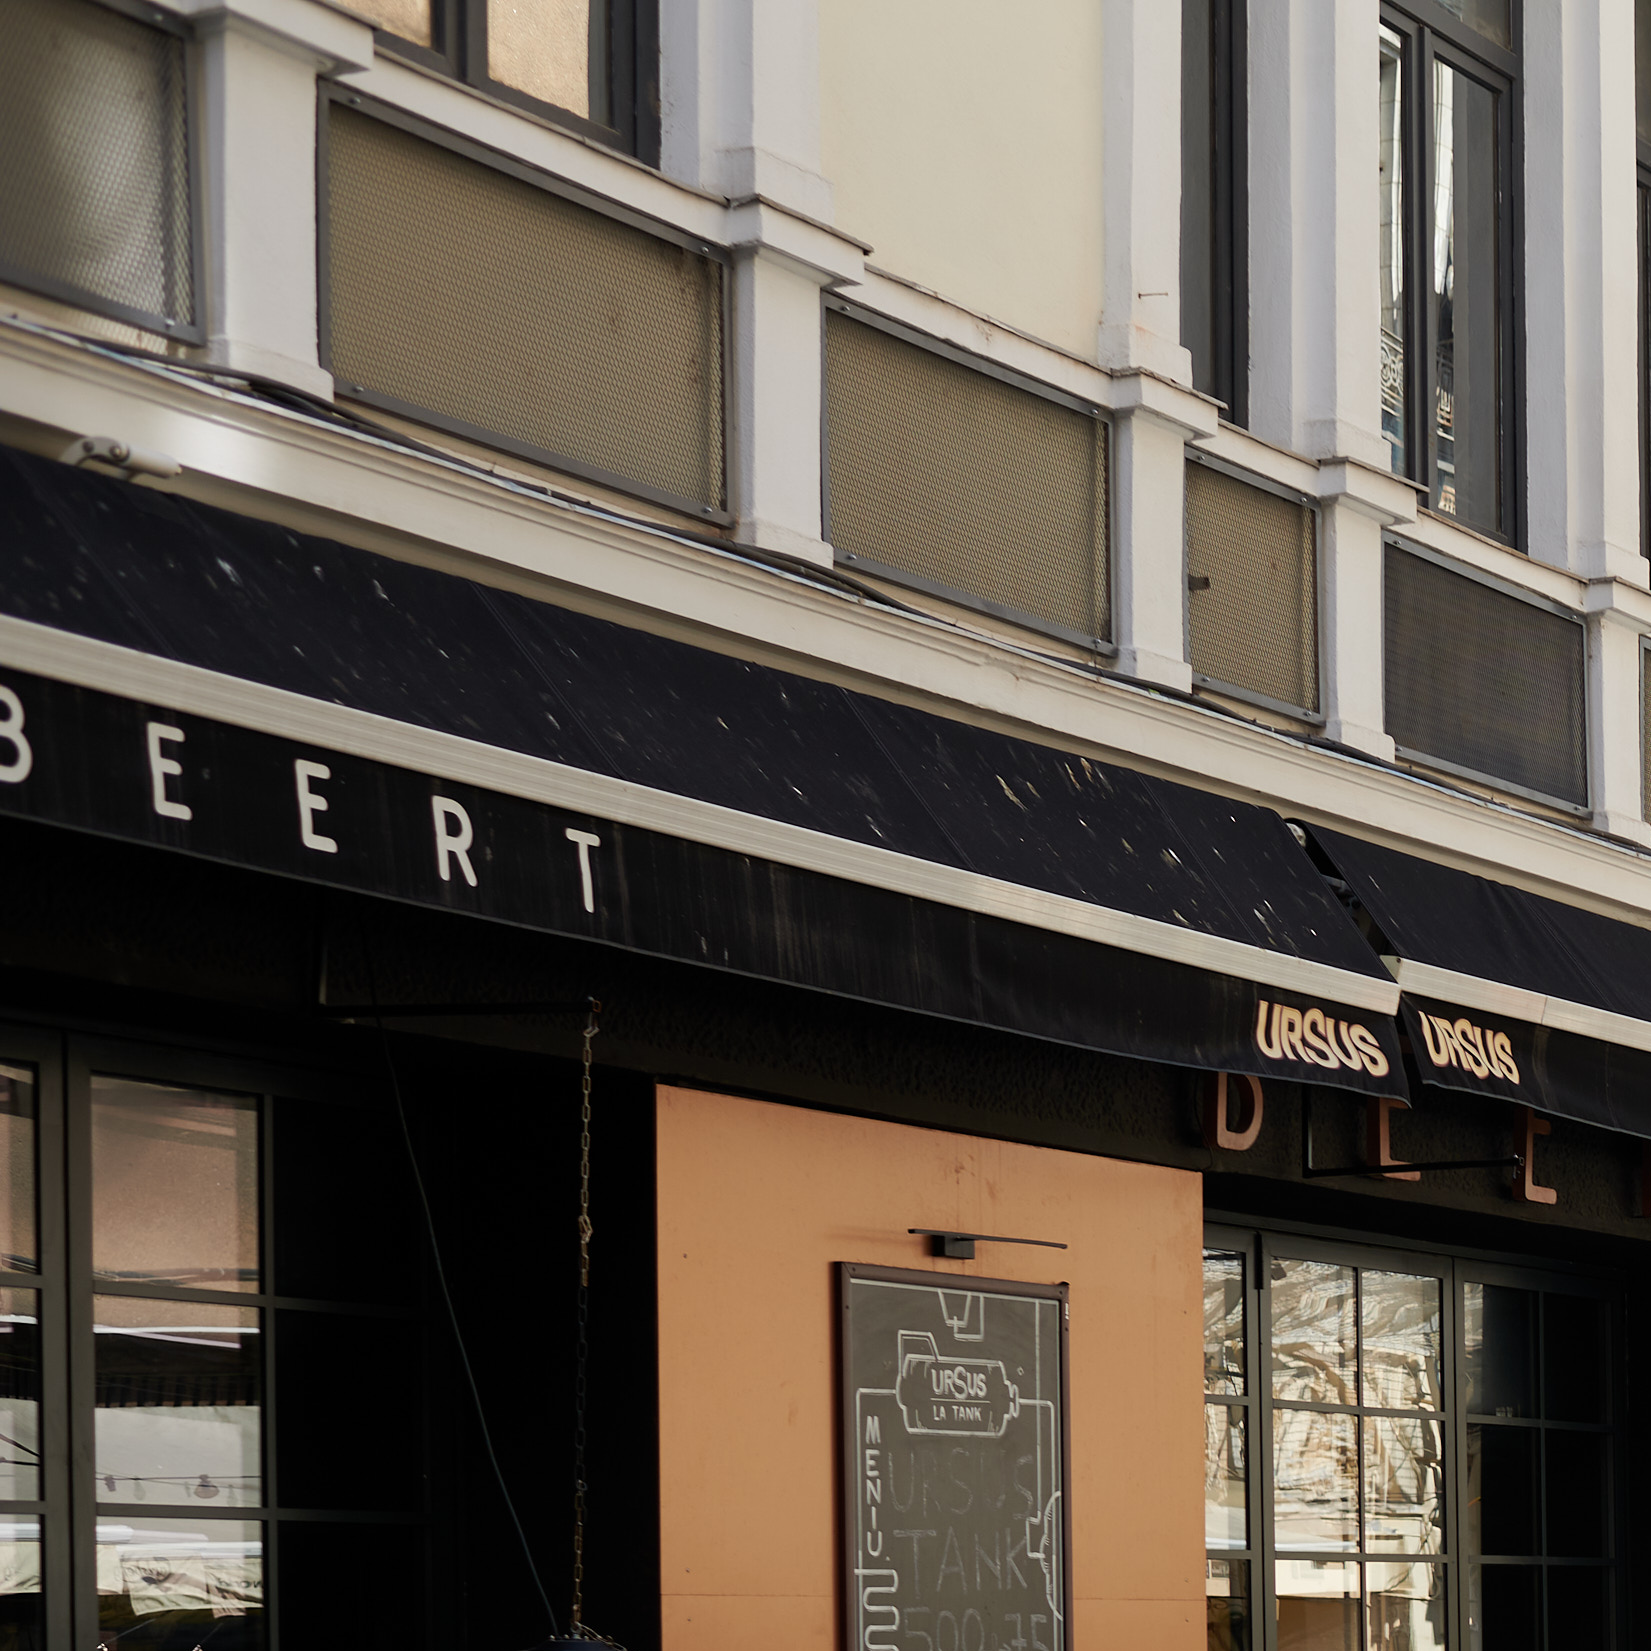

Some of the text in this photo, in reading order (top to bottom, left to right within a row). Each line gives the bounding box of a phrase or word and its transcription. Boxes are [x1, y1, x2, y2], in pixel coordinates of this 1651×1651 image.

[0, 684, 601, 913] BEERT
[1256, 999, 1389, 1077] URSUS
[1419, 1010, 1521, 1085] URSUS
[931, 1366, 987, 1399] URSUS
[933, 1405, 982, 1422] LA TANK
[888, 1447, 1034, 1519] URSUS
[892, 1526, 1029, 1599] TANK
